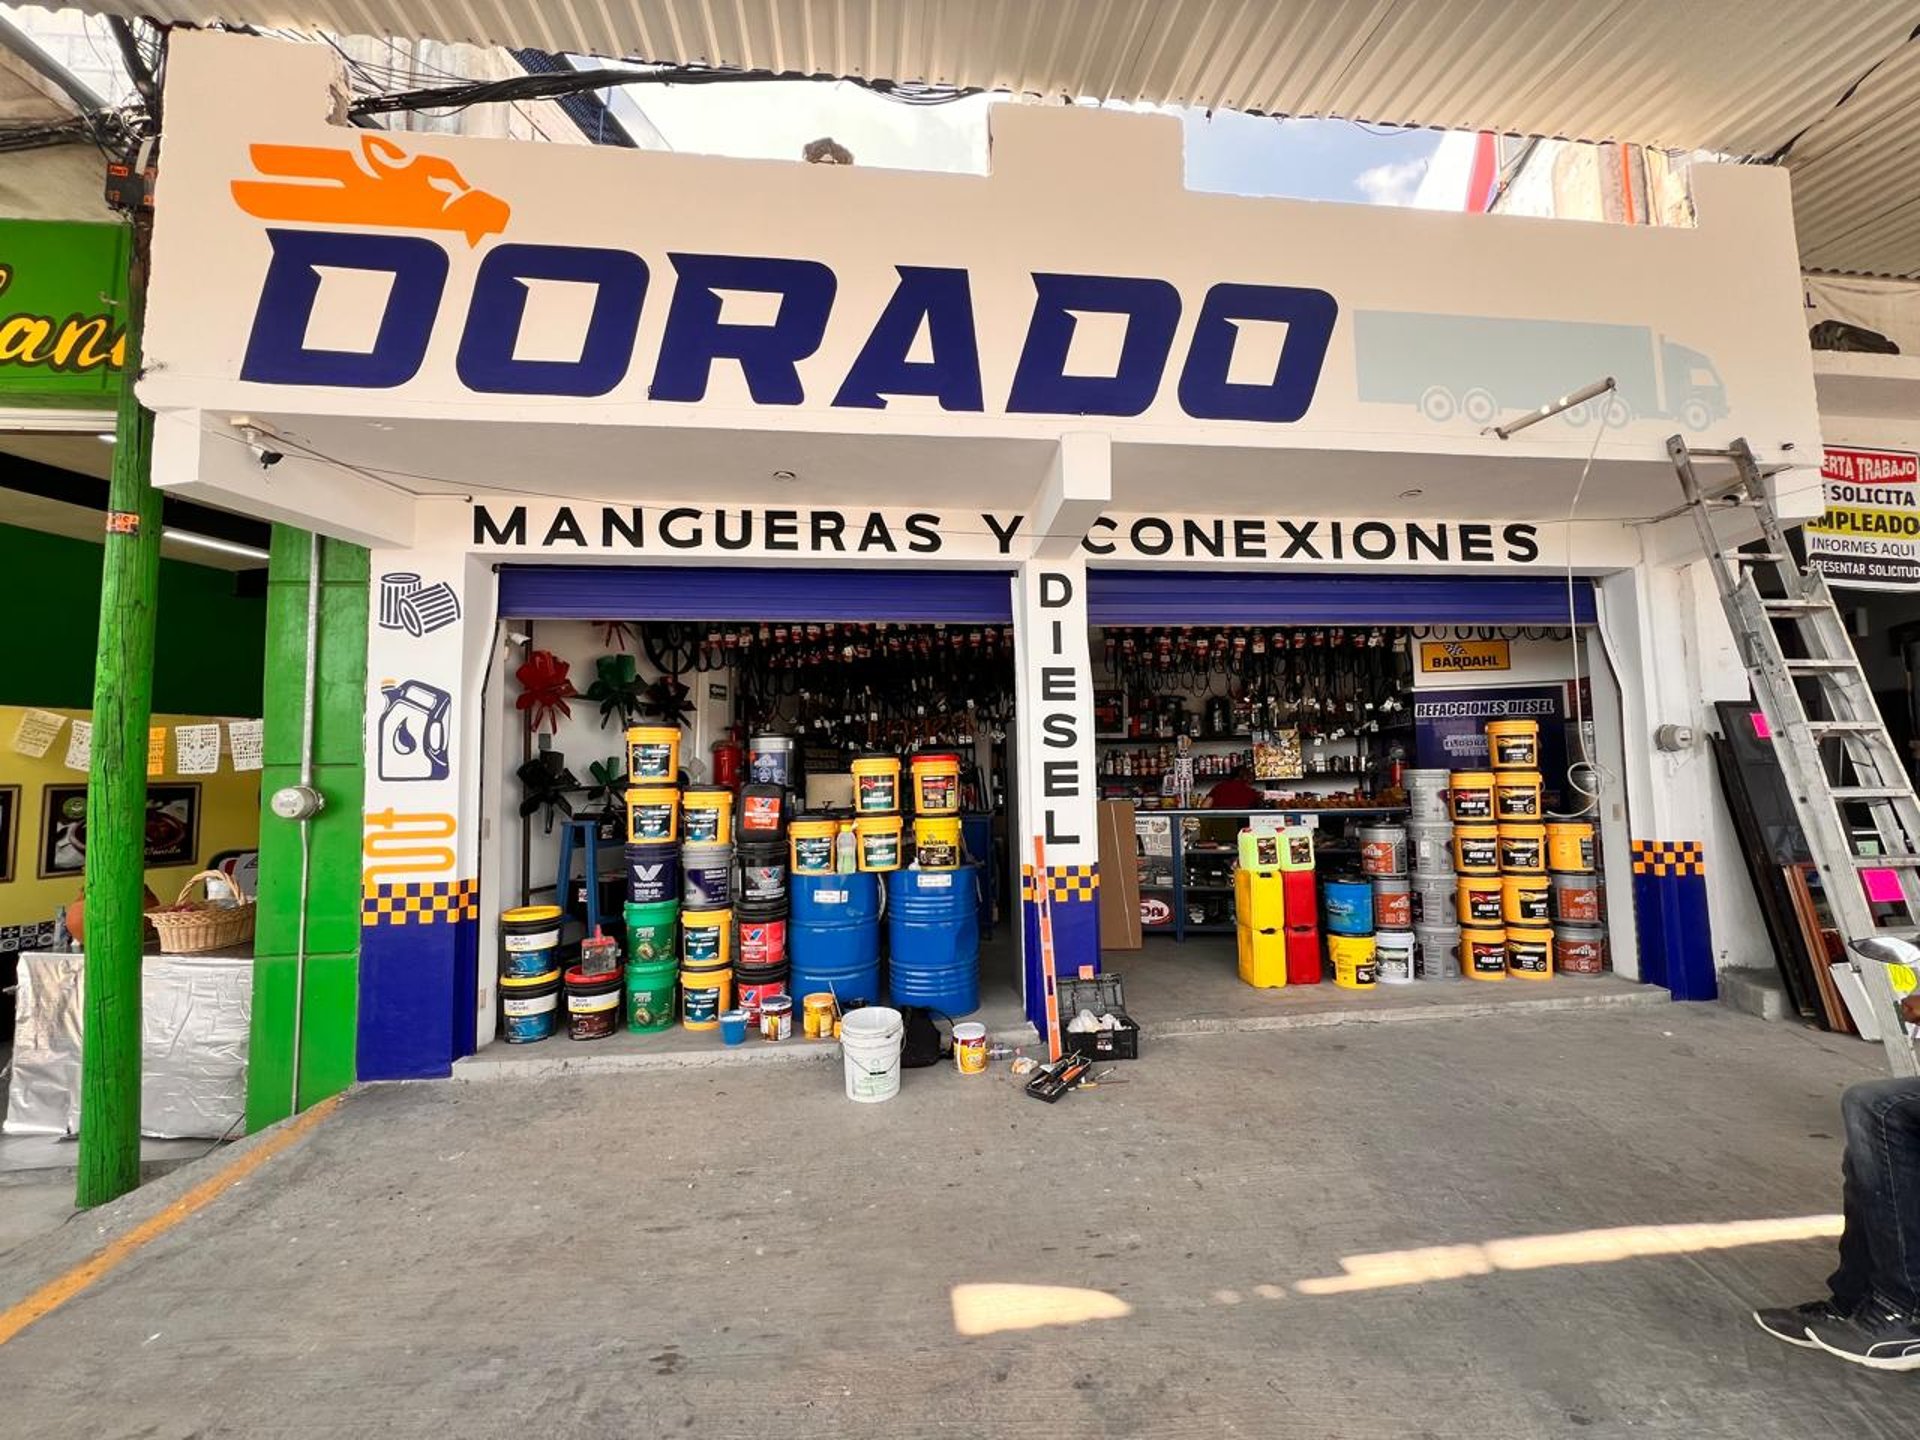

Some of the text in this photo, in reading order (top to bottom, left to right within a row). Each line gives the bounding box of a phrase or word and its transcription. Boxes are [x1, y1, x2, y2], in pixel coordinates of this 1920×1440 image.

[240, 228, 1339, 423] DORADO
[1823, 455, 1915, 481] ERTA TRABAJO
[1831, 485, 1916, 506] SOLICITA
[473, 506, 1539, 562] MANGUERAS Y CONEXIONES
[1807, 511, 1919, 535] MPLEADO
[1812, 537, 1915, 557] INFORMES AQUI
[1810, 560, 1920, 578] PRESENTAR SOLICITUD
[1432, 656, 1499, 668] BARDAHL
[1039, 572, 1080, 845] DIESEL
[1415, 699, 1554, 717] REFACCIONES DIESEL
